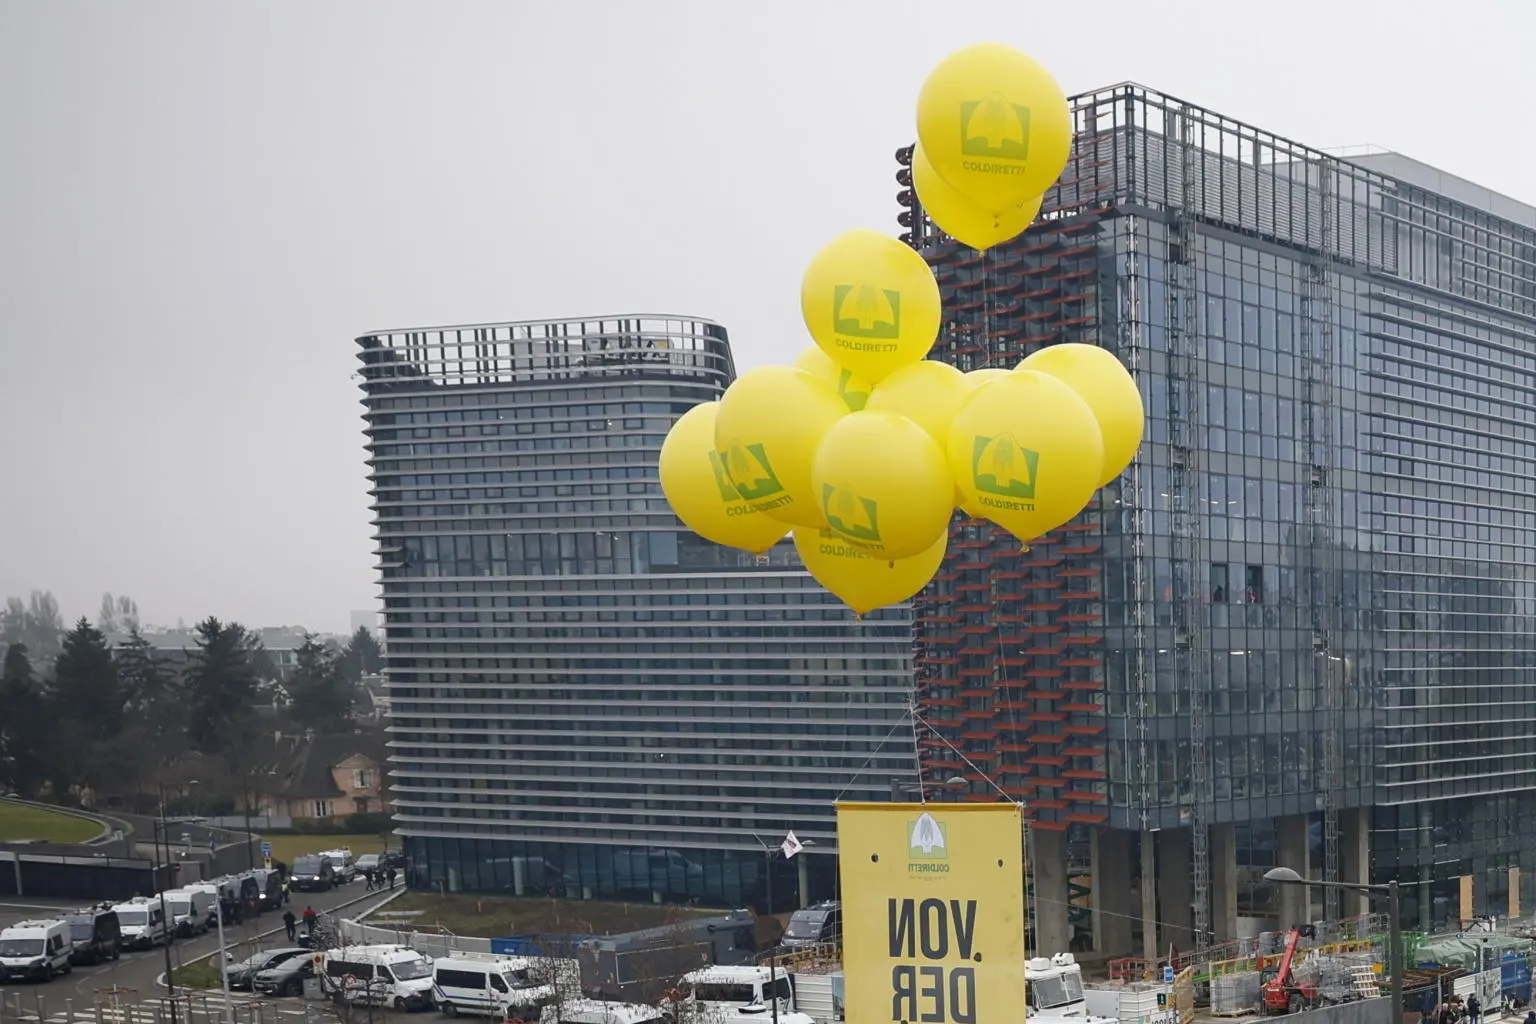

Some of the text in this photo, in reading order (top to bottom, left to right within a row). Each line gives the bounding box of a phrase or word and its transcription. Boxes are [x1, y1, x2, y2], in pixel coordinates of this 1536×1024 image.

[962, 161, 1026, 176] COLDIRETTI
[835, 338, 898, 352] COLDIRETTI
[979, 496, 1034, 511] COLDIRETTI
